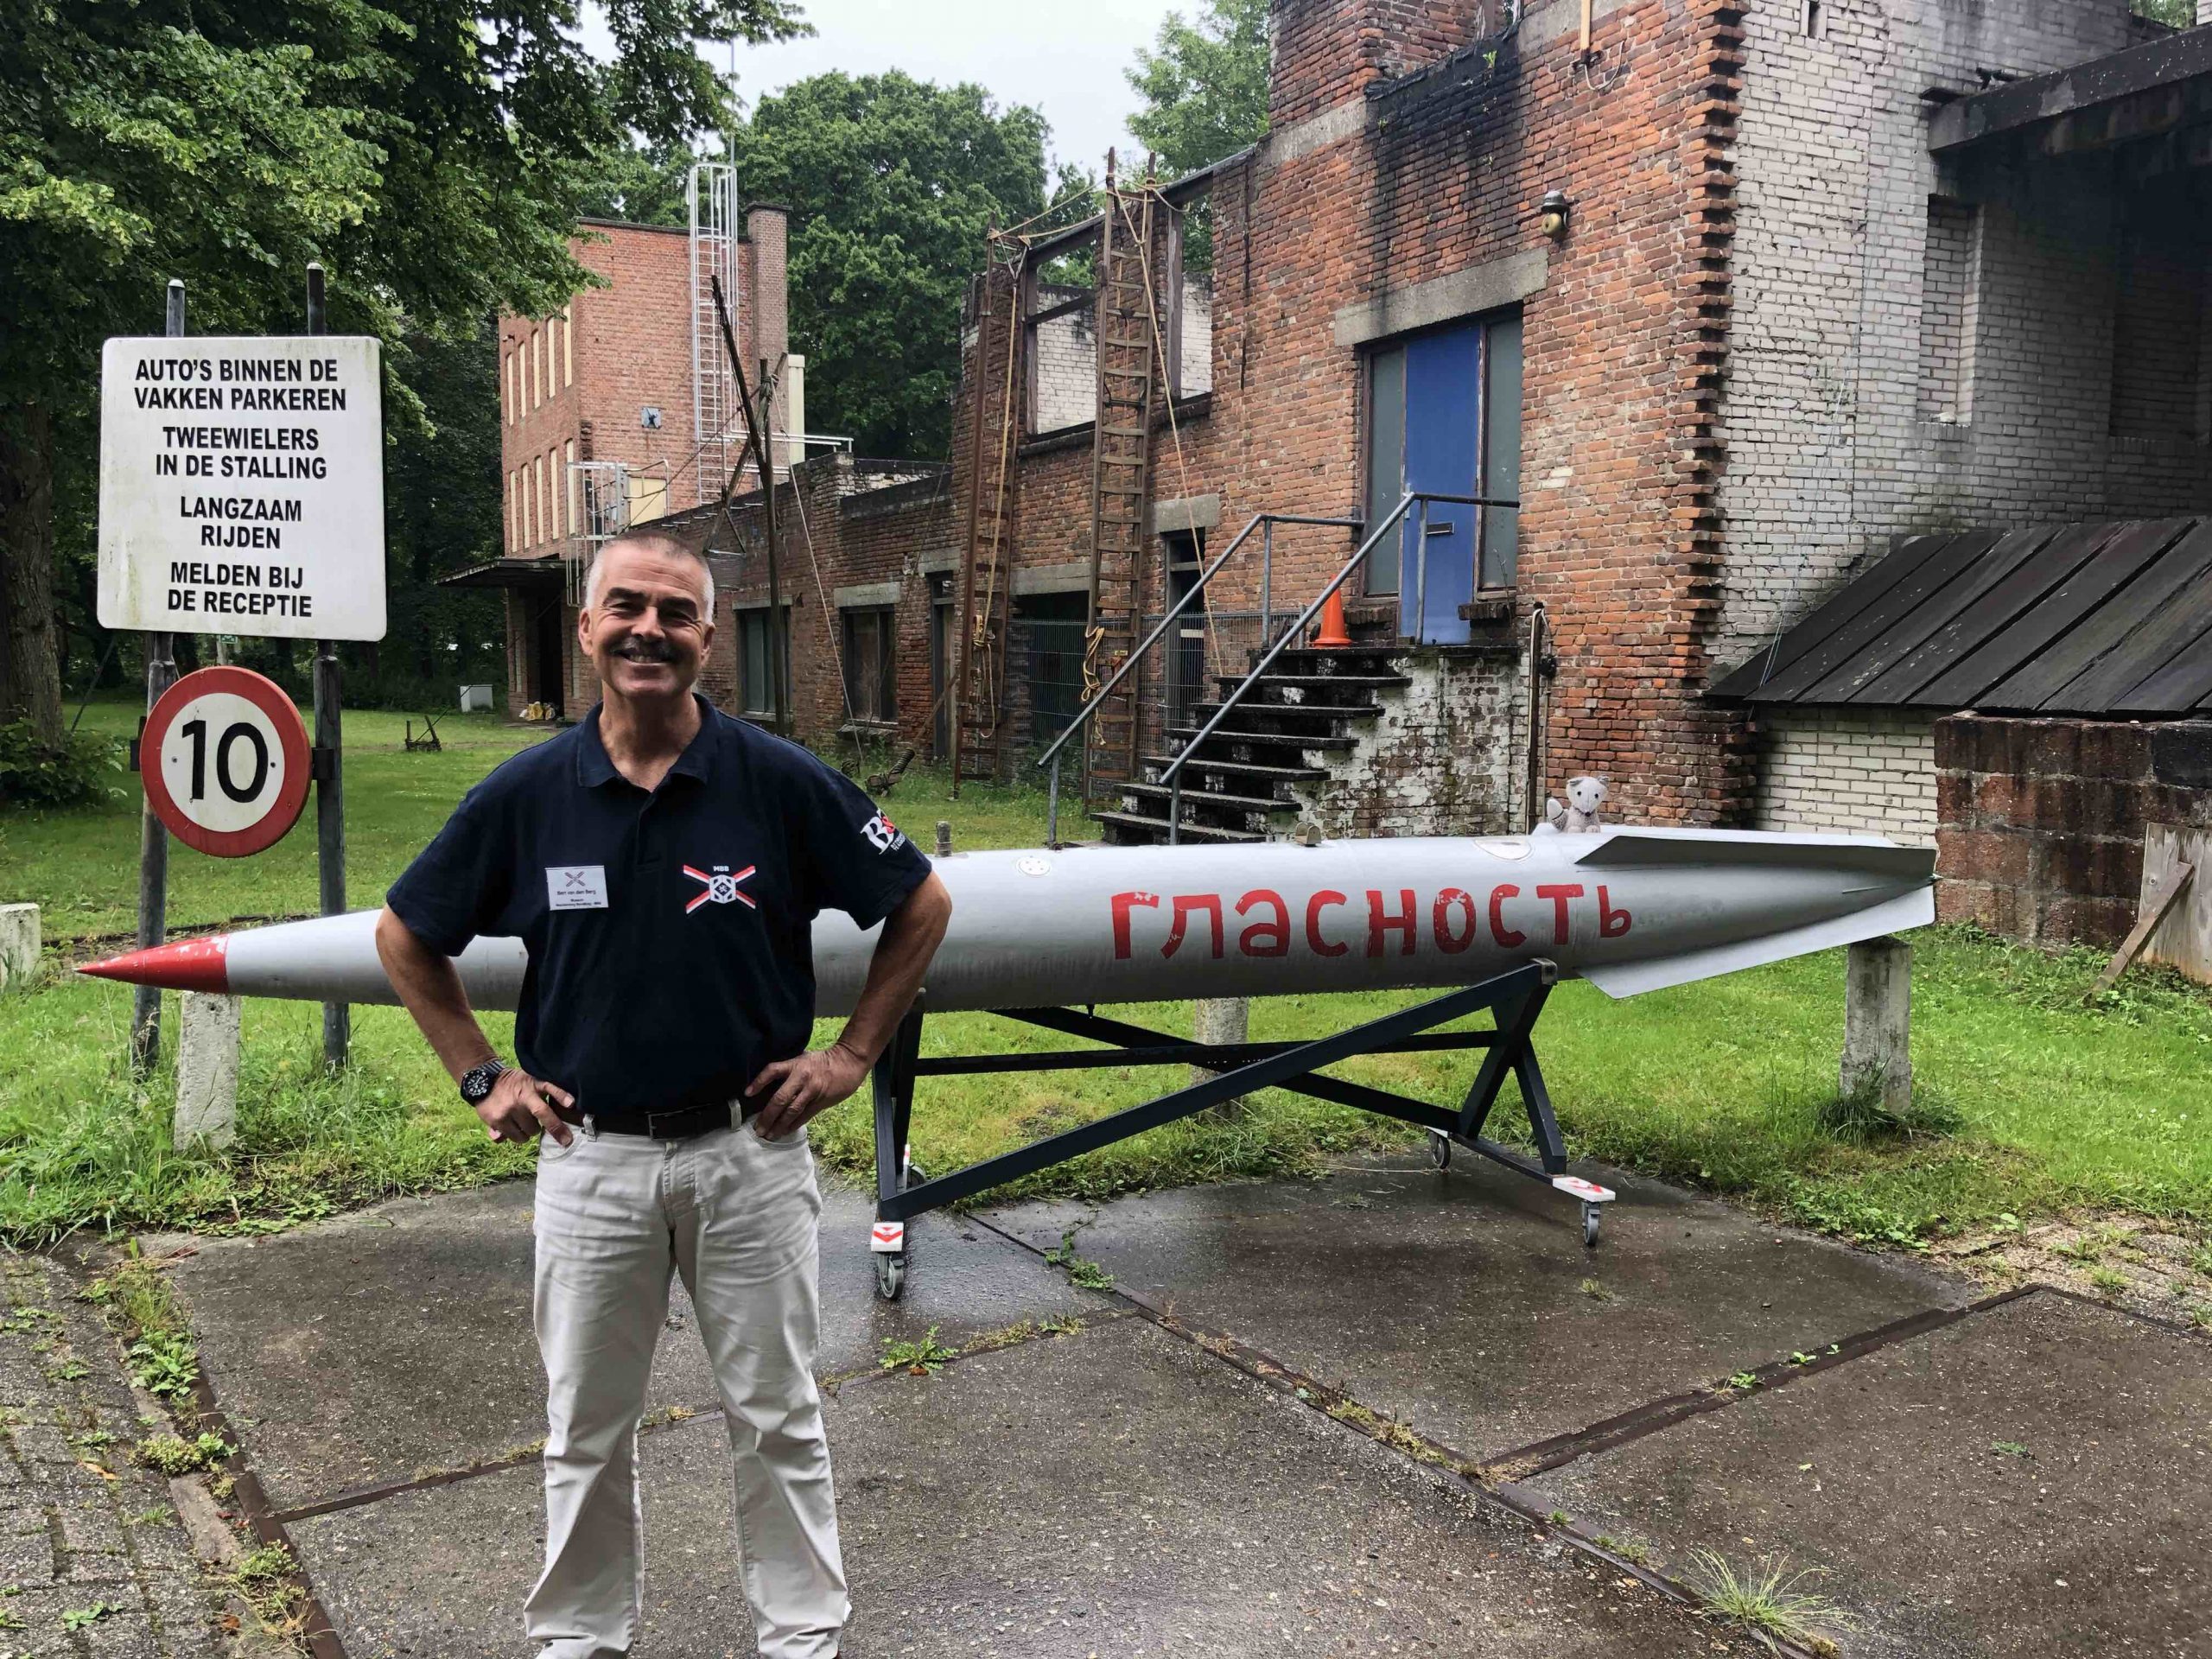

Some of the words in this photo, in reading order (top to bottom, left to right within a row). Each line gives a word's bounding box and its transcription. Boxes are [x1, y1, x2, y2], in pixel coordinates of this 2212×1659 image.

[136, 359, 213, 382] AUTO'S
[219, 359, 302, 382] BINNEN
[310, 359, 338, 382] DE
[135, 387, 223, 410] VAKKEN
[232, 389, 346, 410] PARKEREN
[163, 427, 319, 450] TWEEWIELERS
[156, 454, 178, 476] IN
[187, 455, 213, 477] DE
[221, 455, 327, 479] STALLING
[181, 496, 302, 521] LANGZAAM
[201, 525, 281, 549] RIJDEN
[171, 563, 261, 587] MELDEN
[270, 567, 303, 589] BIJ
[168, 589, 196, 612] DE
[204, 591, 312, 617] RECEPTIE
[182, 720, 269, 803] 10
